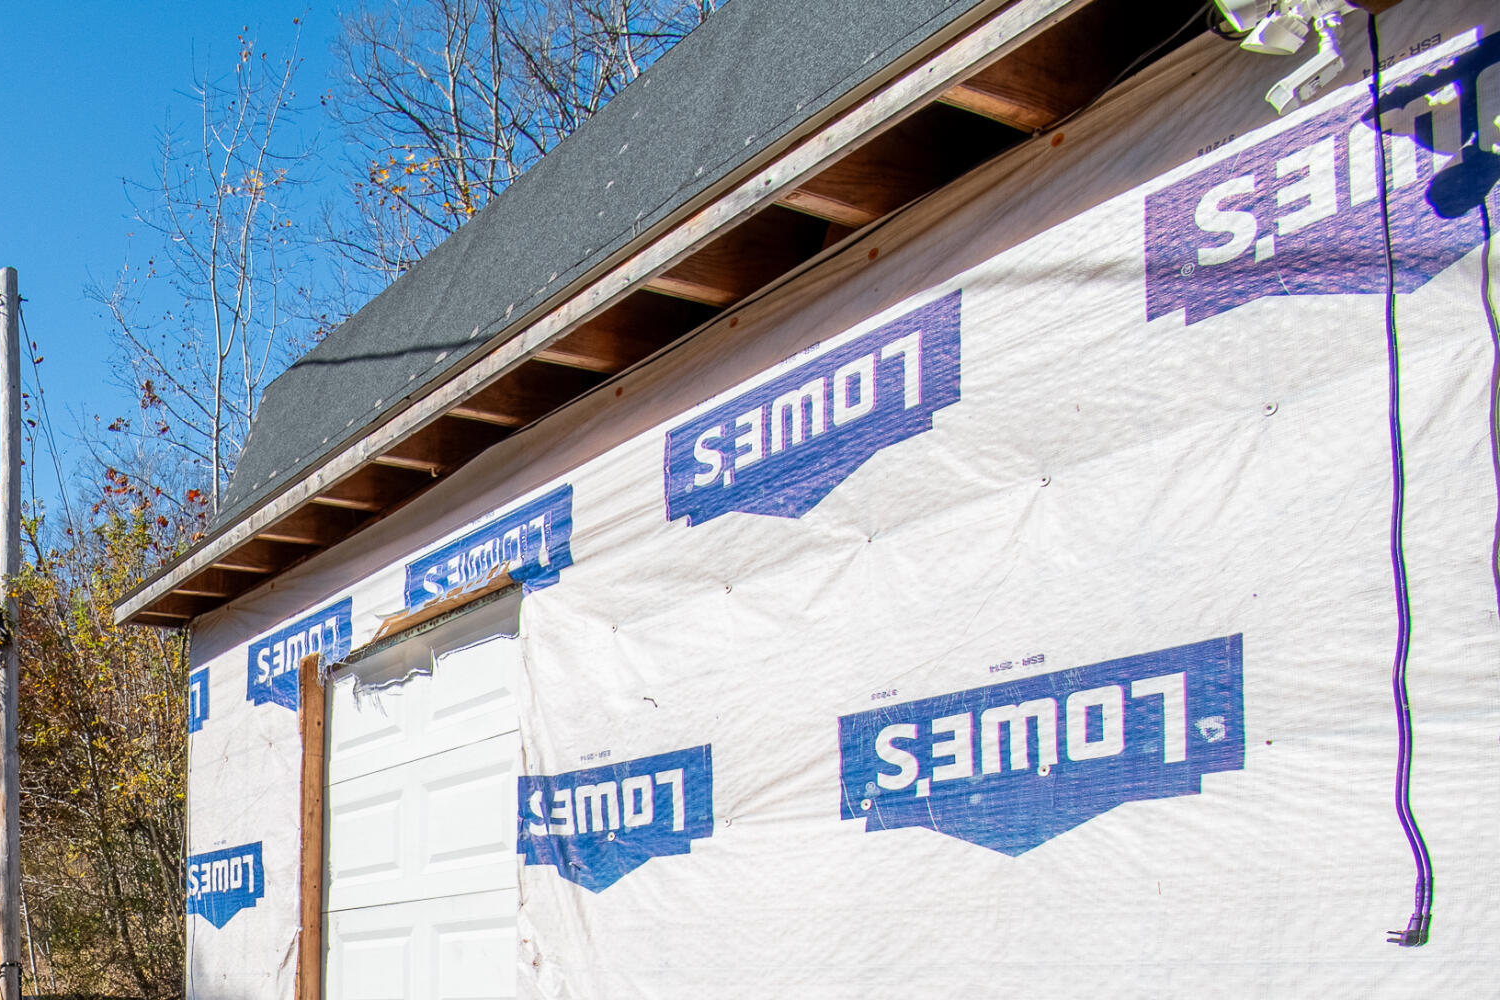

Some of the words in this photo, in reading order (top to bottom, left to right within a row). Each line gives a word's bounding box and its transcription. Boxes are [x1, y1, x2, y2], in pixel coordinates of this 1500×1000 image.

[1362, 54, 1396, 78] 254
[1409, 33, 1442, 53] ESR
[693, 329, 923, 489] LOWE'S
[1022, 653, 1045, 667] ESR
[874, 671, 1188, 798] LOWE'S
[528, 767, 685, 837] LOWES
[188, 854, 255, 901] LOWE'S
